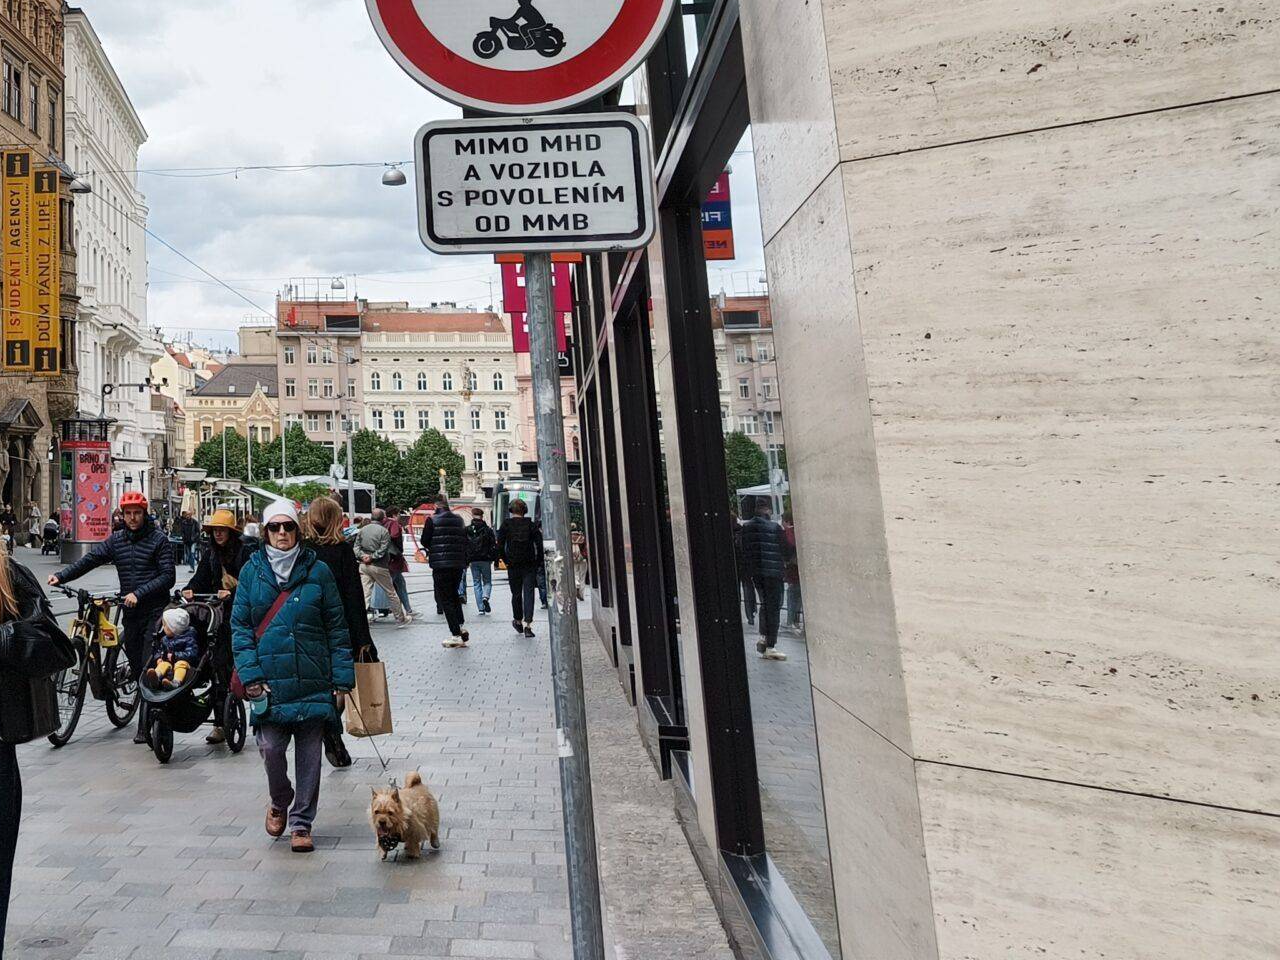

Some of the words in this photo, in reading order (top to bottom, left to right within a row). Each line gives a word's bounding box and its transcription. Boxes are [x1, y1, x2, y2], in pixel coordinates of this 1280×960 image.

[455, 136, 529, 155] MIMO
[541, 134, 602, 152] MHD
[464, 164, 481, 181] A
[490, 160, 606, 180] VOZIDLA
[437, 191, 454, 207] S
[465, 183, 625, 206] POVOLENÍM
[10, 190, 21, 247] AGENCY
[35, 200, 51, 231] LIPÉ
[475, 215, 510, 232] OD
[523, 213, 589, 231] MMB
[38, 238, 51, 246] Z
[36, 253, 51, 296] PÁNŮ
[9, 260, 21, 326] STUDENT
[36, 304, 51, 342] DŮM
[80, 453, 99, 464] BRNO
[91, 463, 107, 474] OPEN
